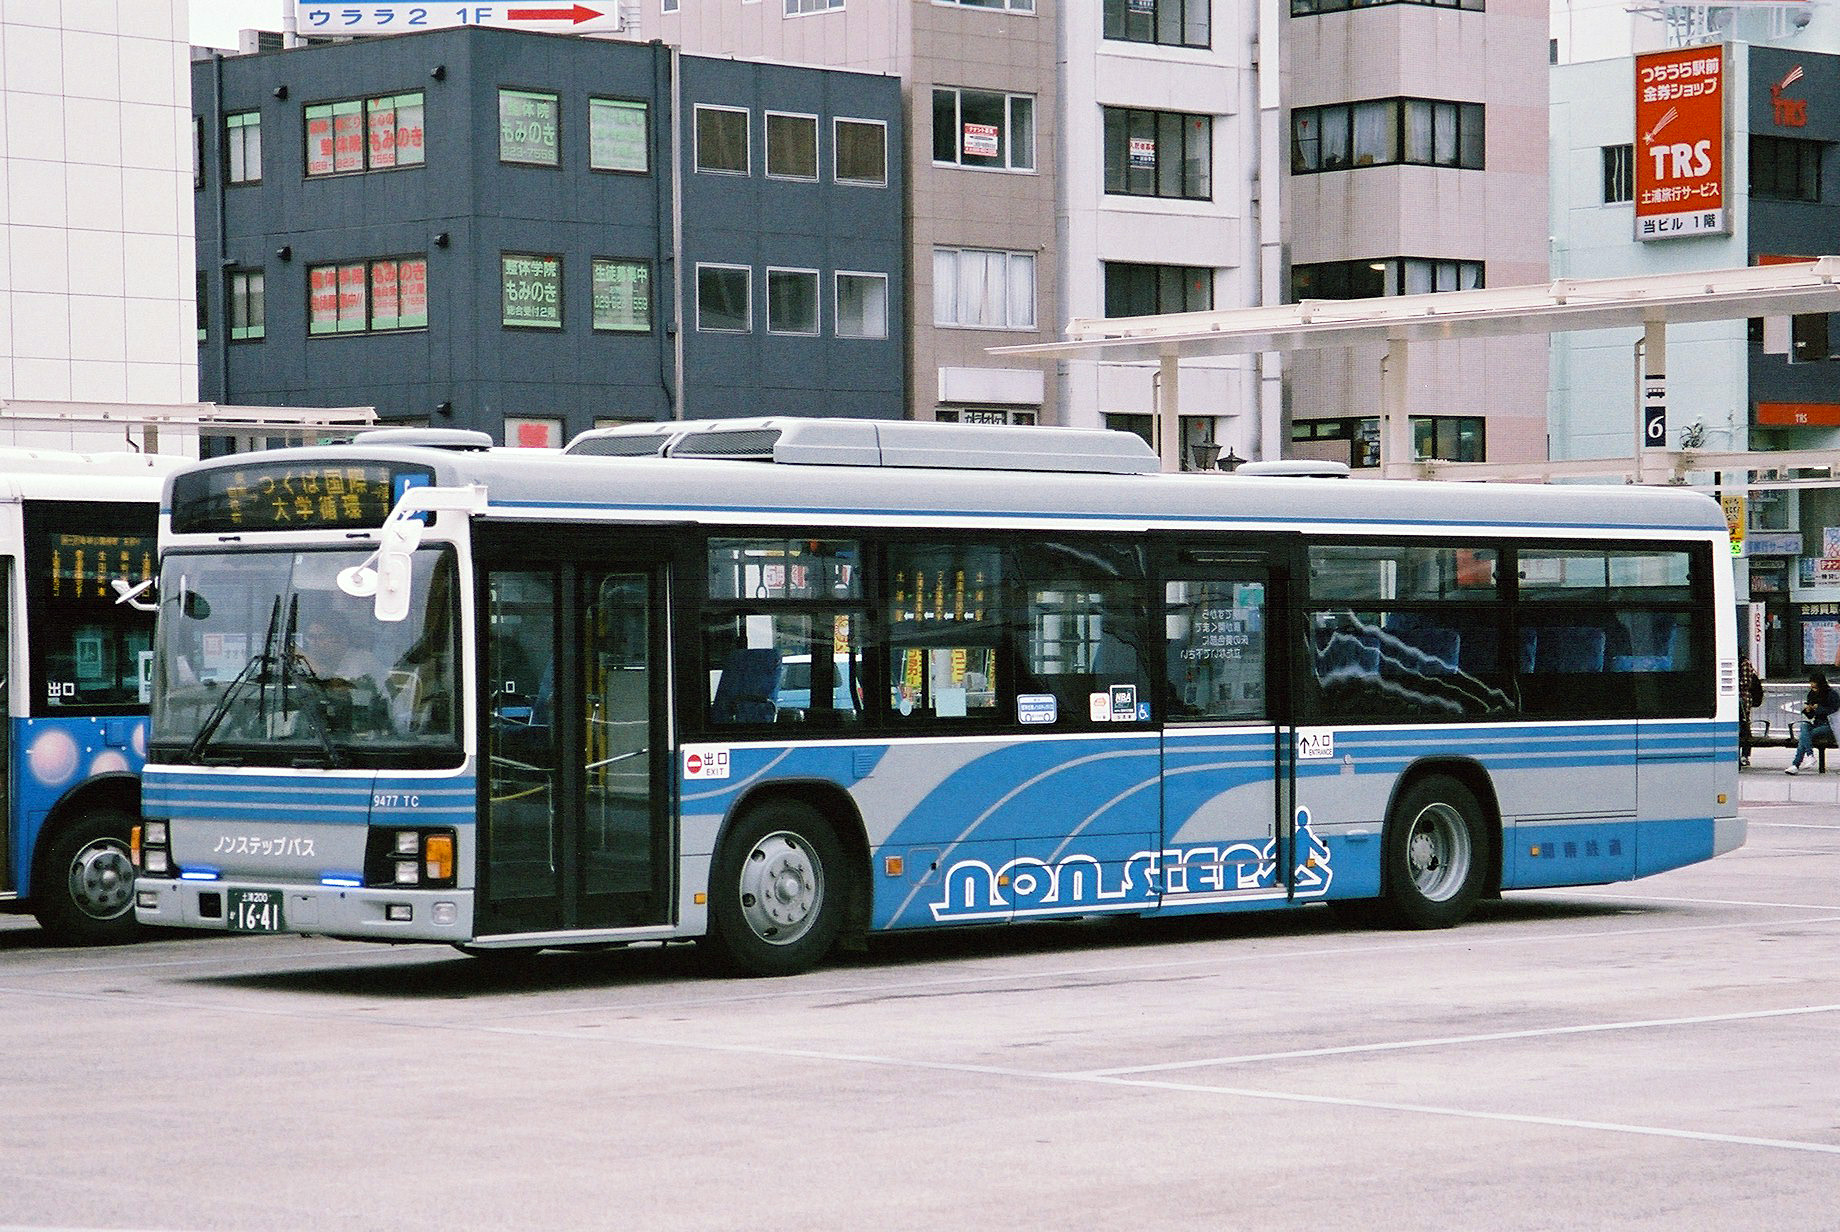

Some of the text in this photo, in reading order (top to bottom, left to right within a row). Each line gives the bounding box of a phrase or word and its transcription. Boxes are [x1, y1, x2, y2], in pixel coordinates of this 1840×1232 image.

[456, 7, 492, 24] 1F
[1641, 57, 1719, 83] つちうら駅前
[1643, 77, 1718, 102] 金券ショップ
[370, 126, 423, 152] もみのき
[501, 119, 556, 146] もみのき
[1649, 139, 1712, 180] TRS
[1641, 182, 1720, 205] 土浦旅行サービス
[1644, 213, 1716, 234] 当ビル 1階
[505, 259, 557, 278] 整体学院
[505, 279, 557, 303] もみのき
[1648, 415, 1665, 439] 6
[258, 467, 368, 496] つくば国際
[48, 682, 75, 697] 出口
[1311, 734, 1331, 748] 入口
[703, 752, 728, 766] 出口
[706, 768, 725, 776] EXIT
[373, 794, 419, 808] 9477 TC
[213, 836, 316, 857] ノンステップバス
